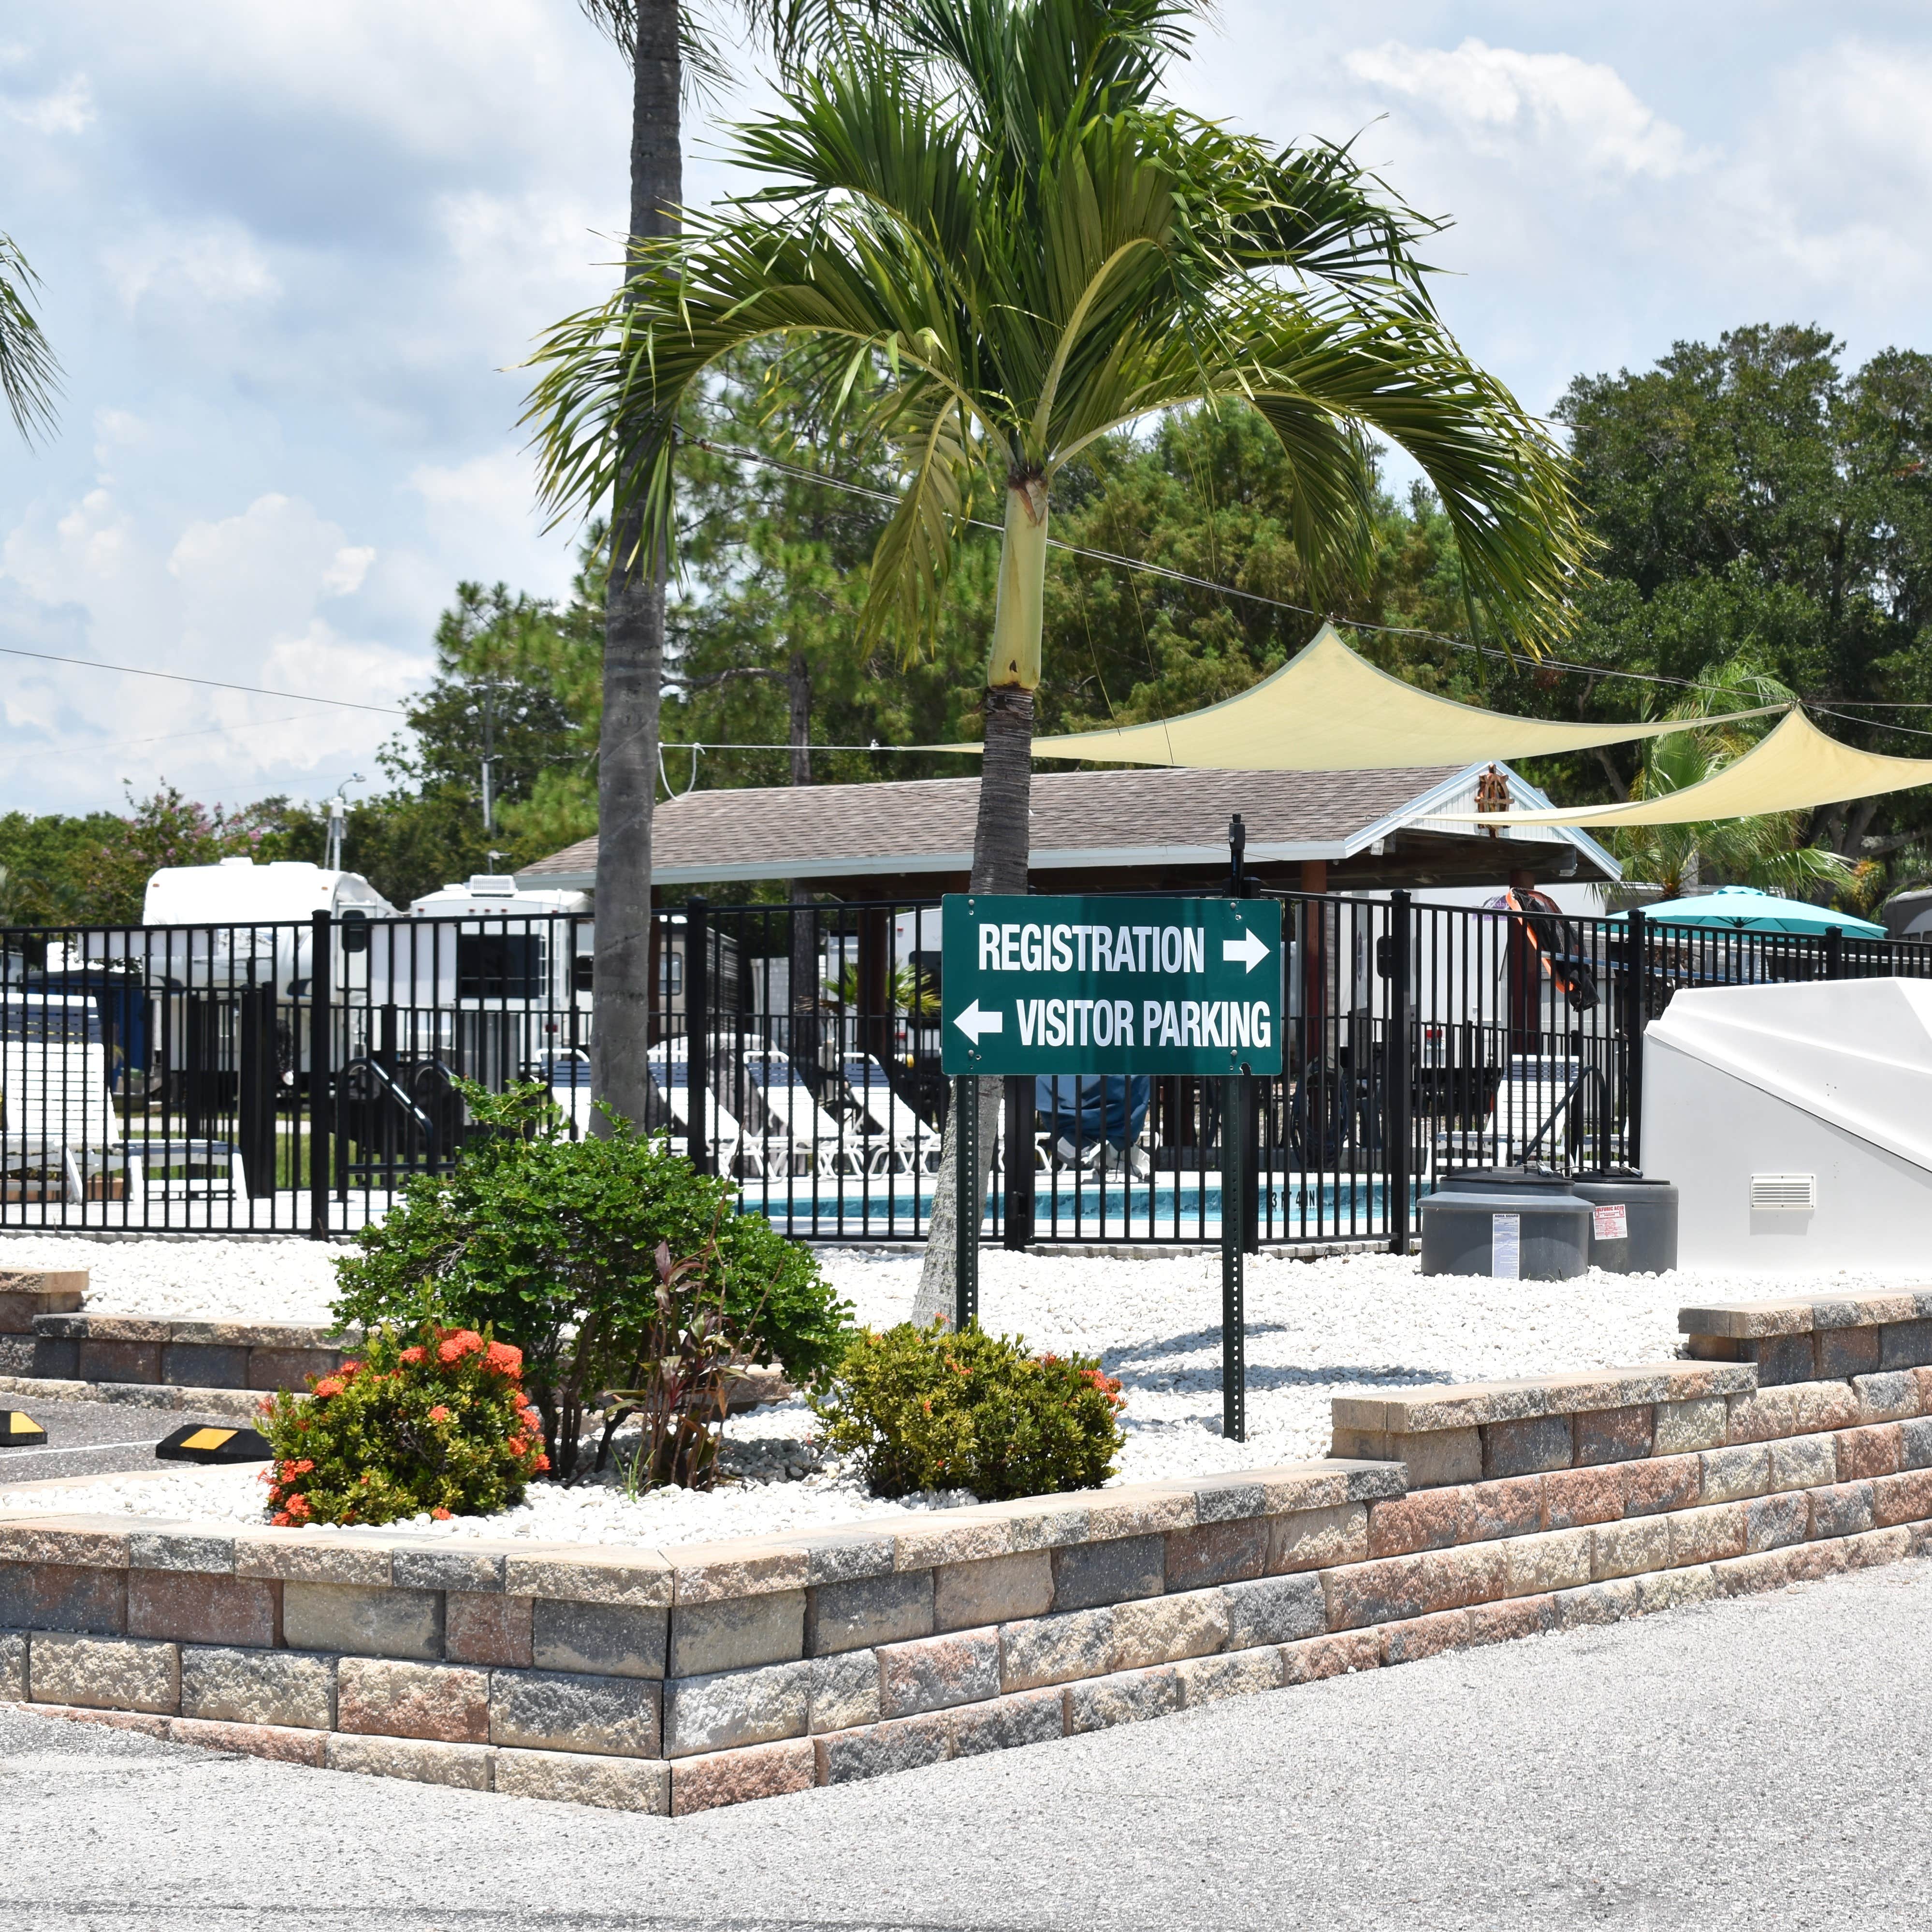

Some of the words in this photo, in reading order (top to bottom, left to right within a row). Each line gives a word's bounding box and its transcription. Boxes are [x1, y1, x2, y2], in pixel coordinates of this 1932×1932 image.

[978, 923, 1205, 973] REGISTRATION
[1016, 999, 1134, 1047] VISITOR
[1143, 1001, 1271, 1047] PARKING
[1272, 1192, 1277, 1207] 3
[1295, 1191, 1301, 1206] 4
